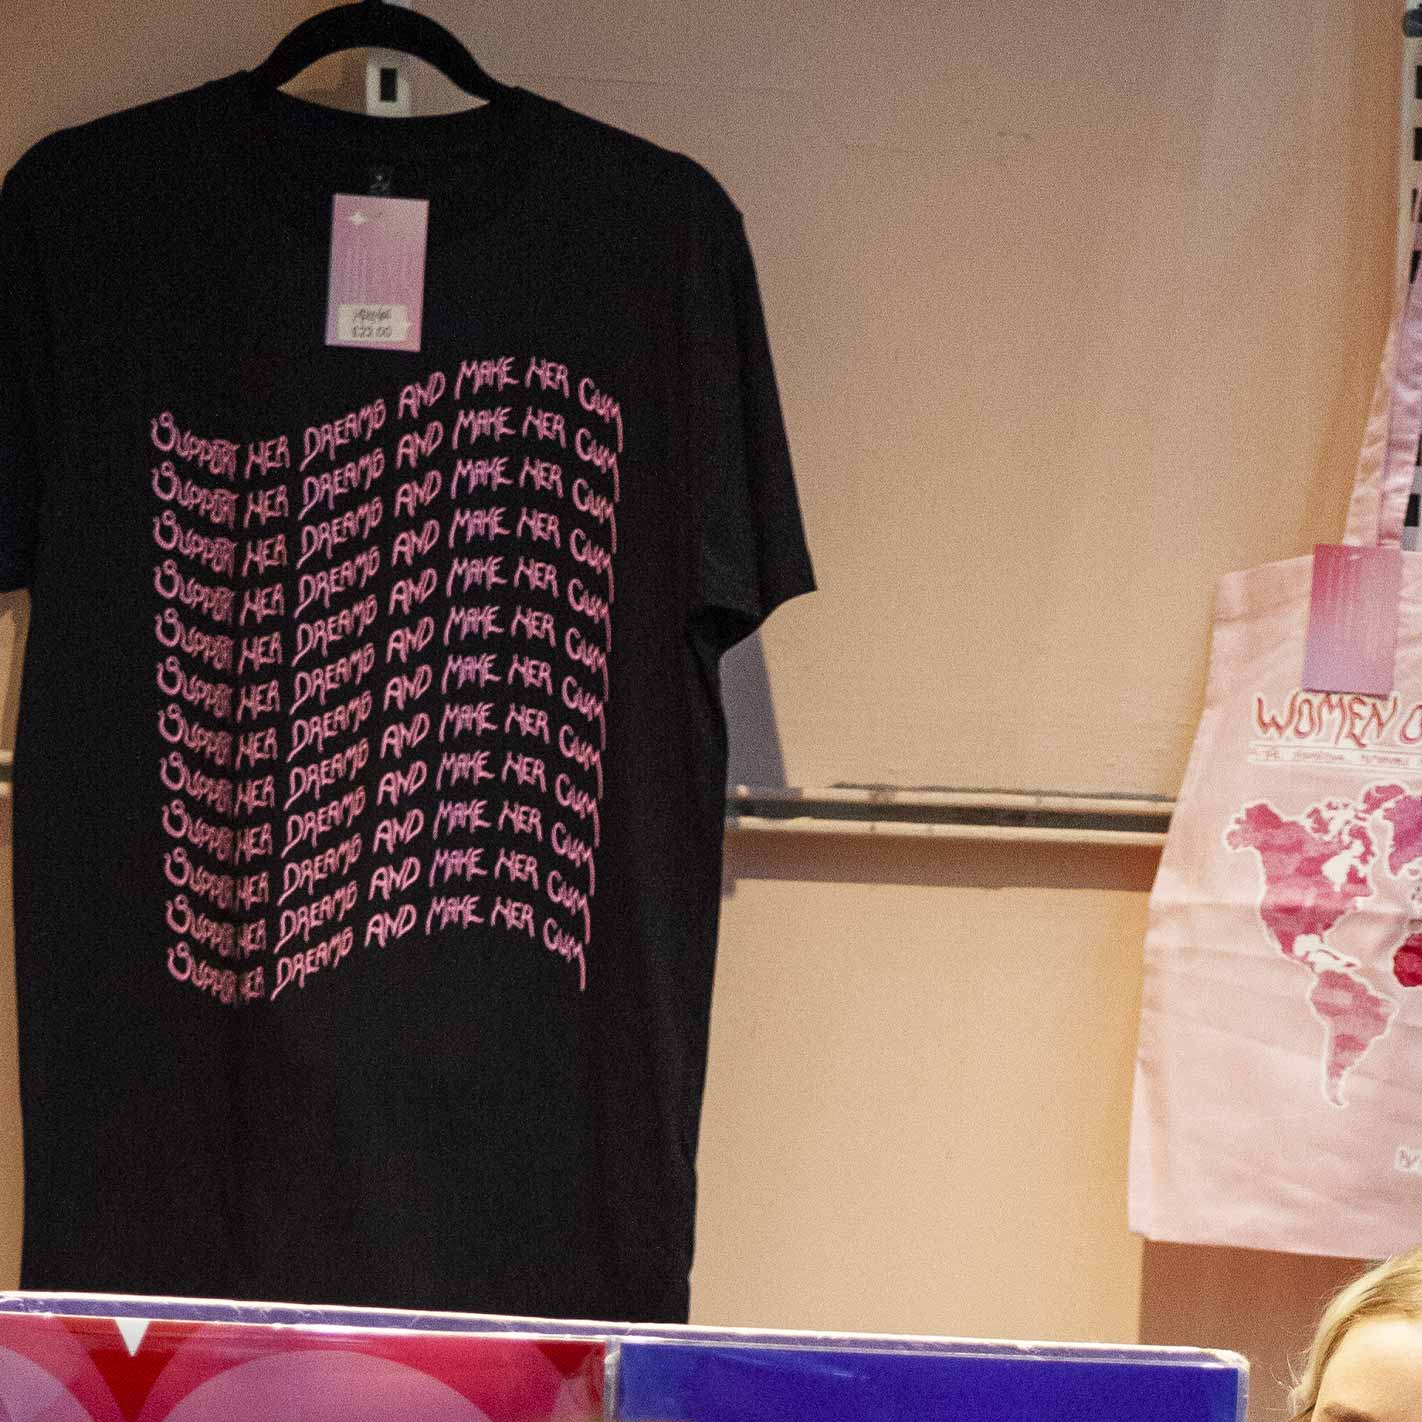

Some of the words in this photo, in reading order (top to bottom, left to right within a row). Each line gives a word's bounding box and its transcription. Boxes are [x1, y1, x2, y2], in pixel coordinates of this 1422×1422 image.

[243, 484, 288, 527] HER
[396, 421, 443, 468] AND
[453, 407, 516, 448] MAKE
[522, 406, 566, 447] HER
[245, 435, 290, 479] HER
[399, 372, 445, 419] AND
[455, 357, 519, 399] MAKE
[525, 356, 569, 398] HER
[240, 582, 284, 624] HER
[391, 519, 439, 565] AND
[448, 506, 510, 547] MAKE
[517, 505, 561, 546] HER
[242, 533, 286, 575] HER
[394, 470, 441, 516] AND
[451, 456, 513, 498] MAKE
[519, 455, 563, 497] HER
[237, 680, 280, 720] HER
[386, 616, 434, 662] AND
[444, 605, 504, 645] MAKE
[511, 605, 555, 645] HER
[238, 631, 282, 672] HER
[389, 567, 436, 613] AND
[446, 555, 507, 596] MAKE
[514, 555, 558, 596] HER
[237, 728, 277, 767] HER
[384, 665, 432, 710] AND
[442, 654, 500, 695] MAKE
[508, 654, 552, 695] HER
[238, 775, 275, 813] HER
[380, 713, 429, 758] AND
[438, 702, 497, 743] MAKE
[505, 703, 549, 743] HER
[1256, 691, 1397, 748] WOMEN
[238, 823, 272, 860] HER
[376, 760, 426, 805] AND
[435, 751, 494, 791] MAKE
[502, 751, 545, 792] HER
[372, 808, 422, 852] AND
[432, 799, 491, 839] MAKE
[498, 800, 542, 841] HER
[364, 903, 416, 947] AND
[425, 895, 485, 936] MAKE
[492, 897, 535, 938] HER
[368, 855, 419, 900] AND
[428, 847, 488, 888] MAKE
[495, 848, 538, 889] HER
